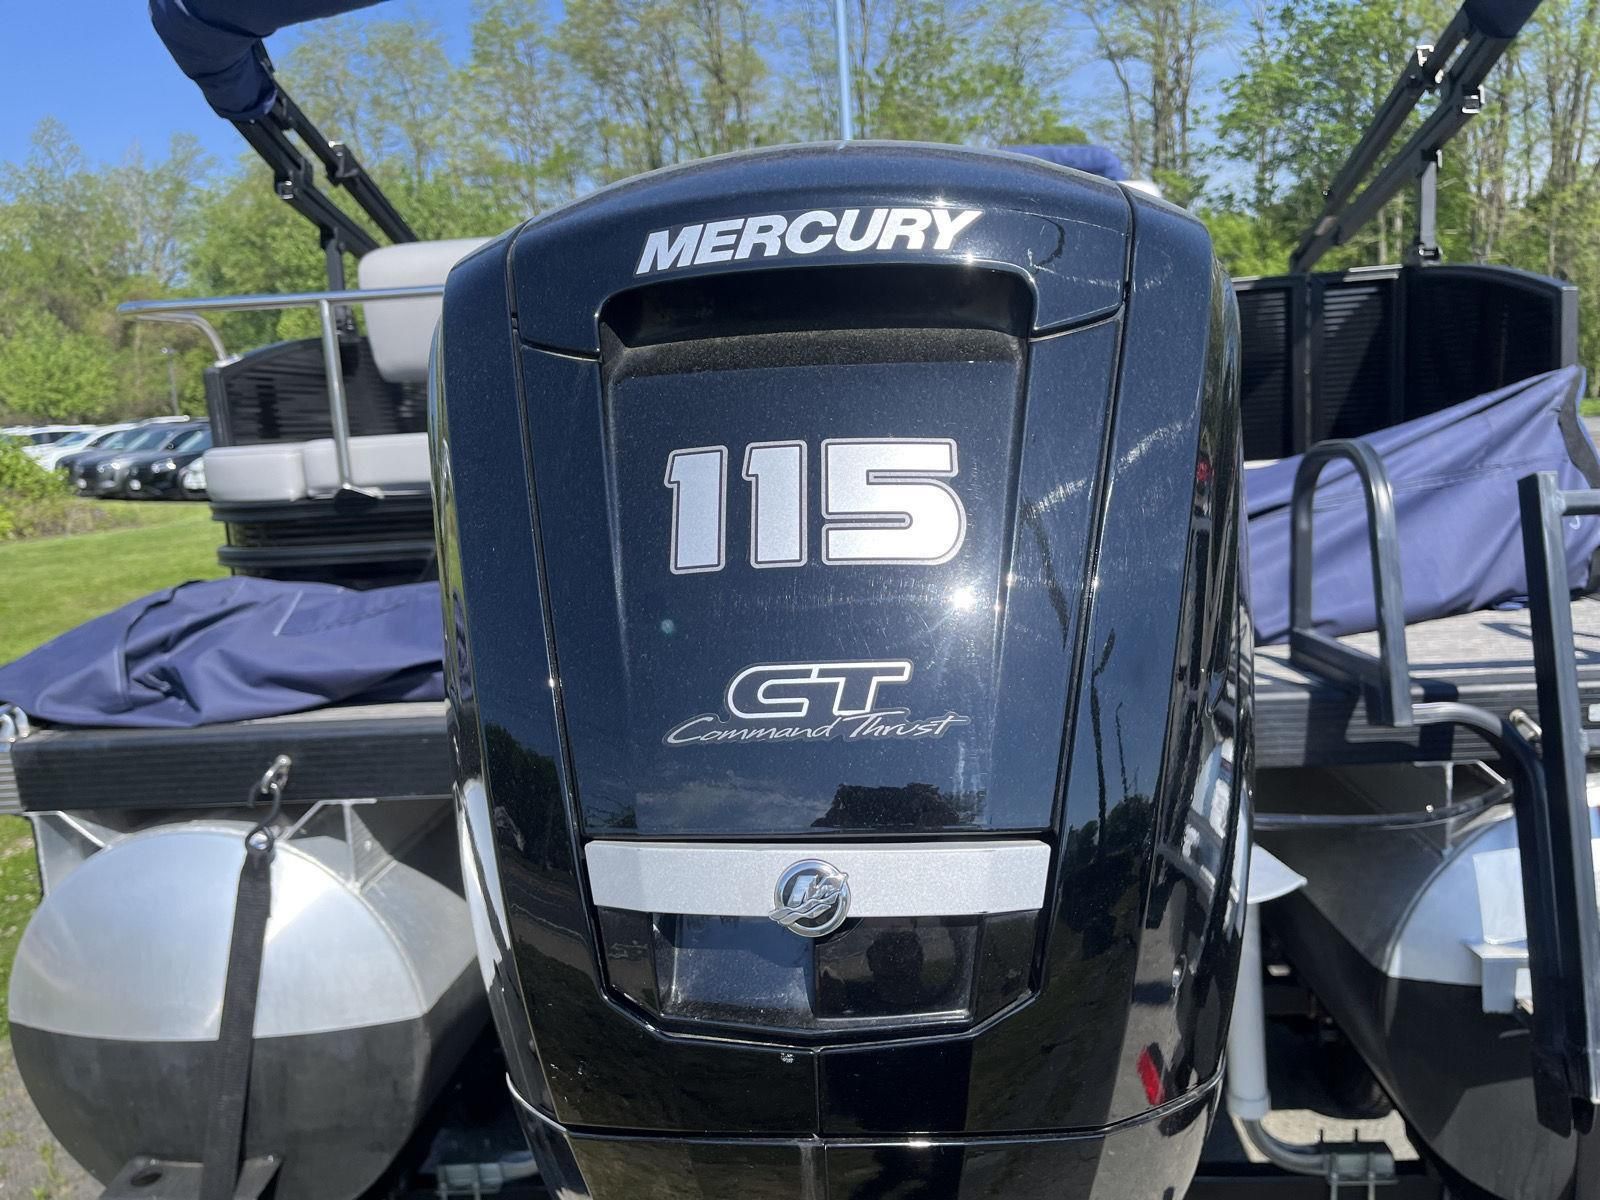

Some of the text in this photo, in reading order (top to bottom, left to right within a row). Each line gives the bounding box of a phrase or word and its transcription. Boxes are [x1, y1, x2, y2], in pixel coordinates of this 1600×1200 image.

[635, 208, 984, 275] MERCURY
[664, 437, 967, 575] 115
[727, 661, 911, 719] GT
[666, 710, 968, 744] Command Thrust
